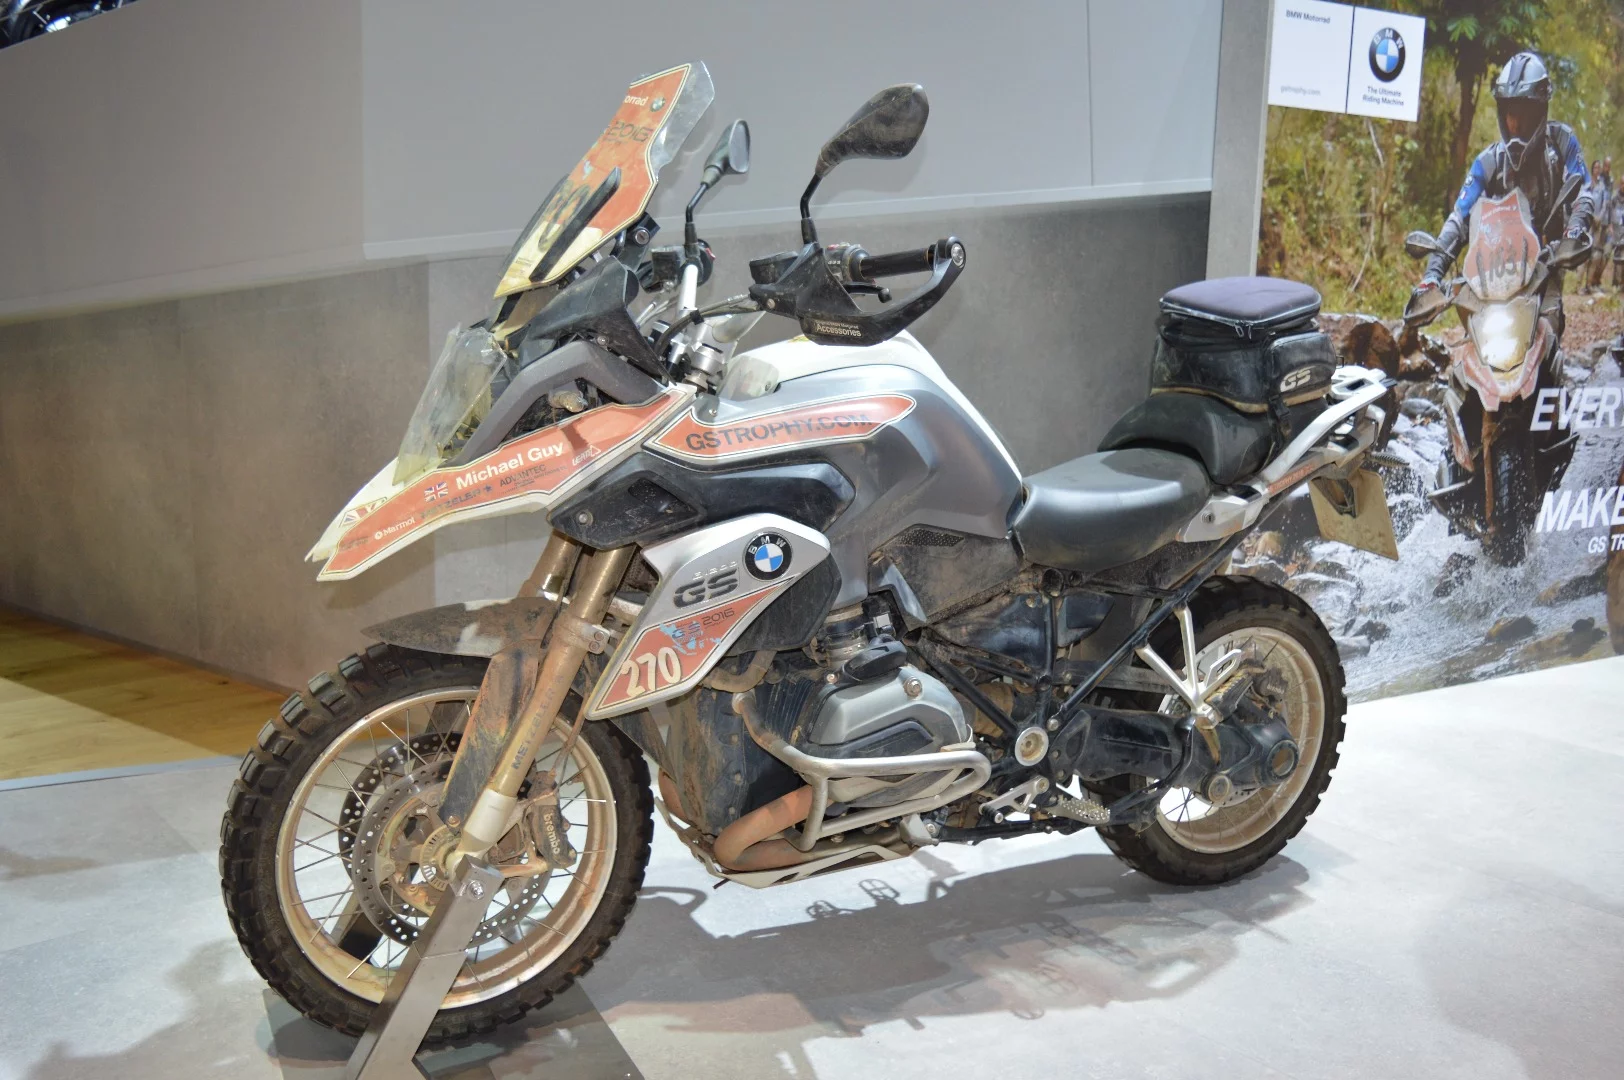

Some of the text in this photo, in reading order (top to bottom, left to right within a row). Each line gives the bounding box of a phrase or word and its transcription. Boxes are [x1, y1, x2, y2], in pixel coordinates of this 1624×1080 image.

[1286, 10, 1331, 24] BMW Motorrad
[1362, 95, 1405, 107] Riding Machine
[1367, 86, 1402, 97] The Ultimate
[607, 121, 654, 143] 2016
[816, 323, 862, 337] Accessories
[1280, 368, 1311, 392] GS
[1530, 386, 1624, 432] EVER
[685, 413, 873, 451] GSTROPHY.COM
[456, 454, 524, 490] Michael
[527, 442, 564, 463] Guy
[499, 464, 547, 487] ADVANTEC
[747, 535, 787, 556] BMW
[1588, 536, 1608, 554] GS
[673, 568, 739, 610] GS
[701, 607, 735, 626] 2016
[621, 647, 683, 698] 270
[543, 812, 562, 856] brembo
